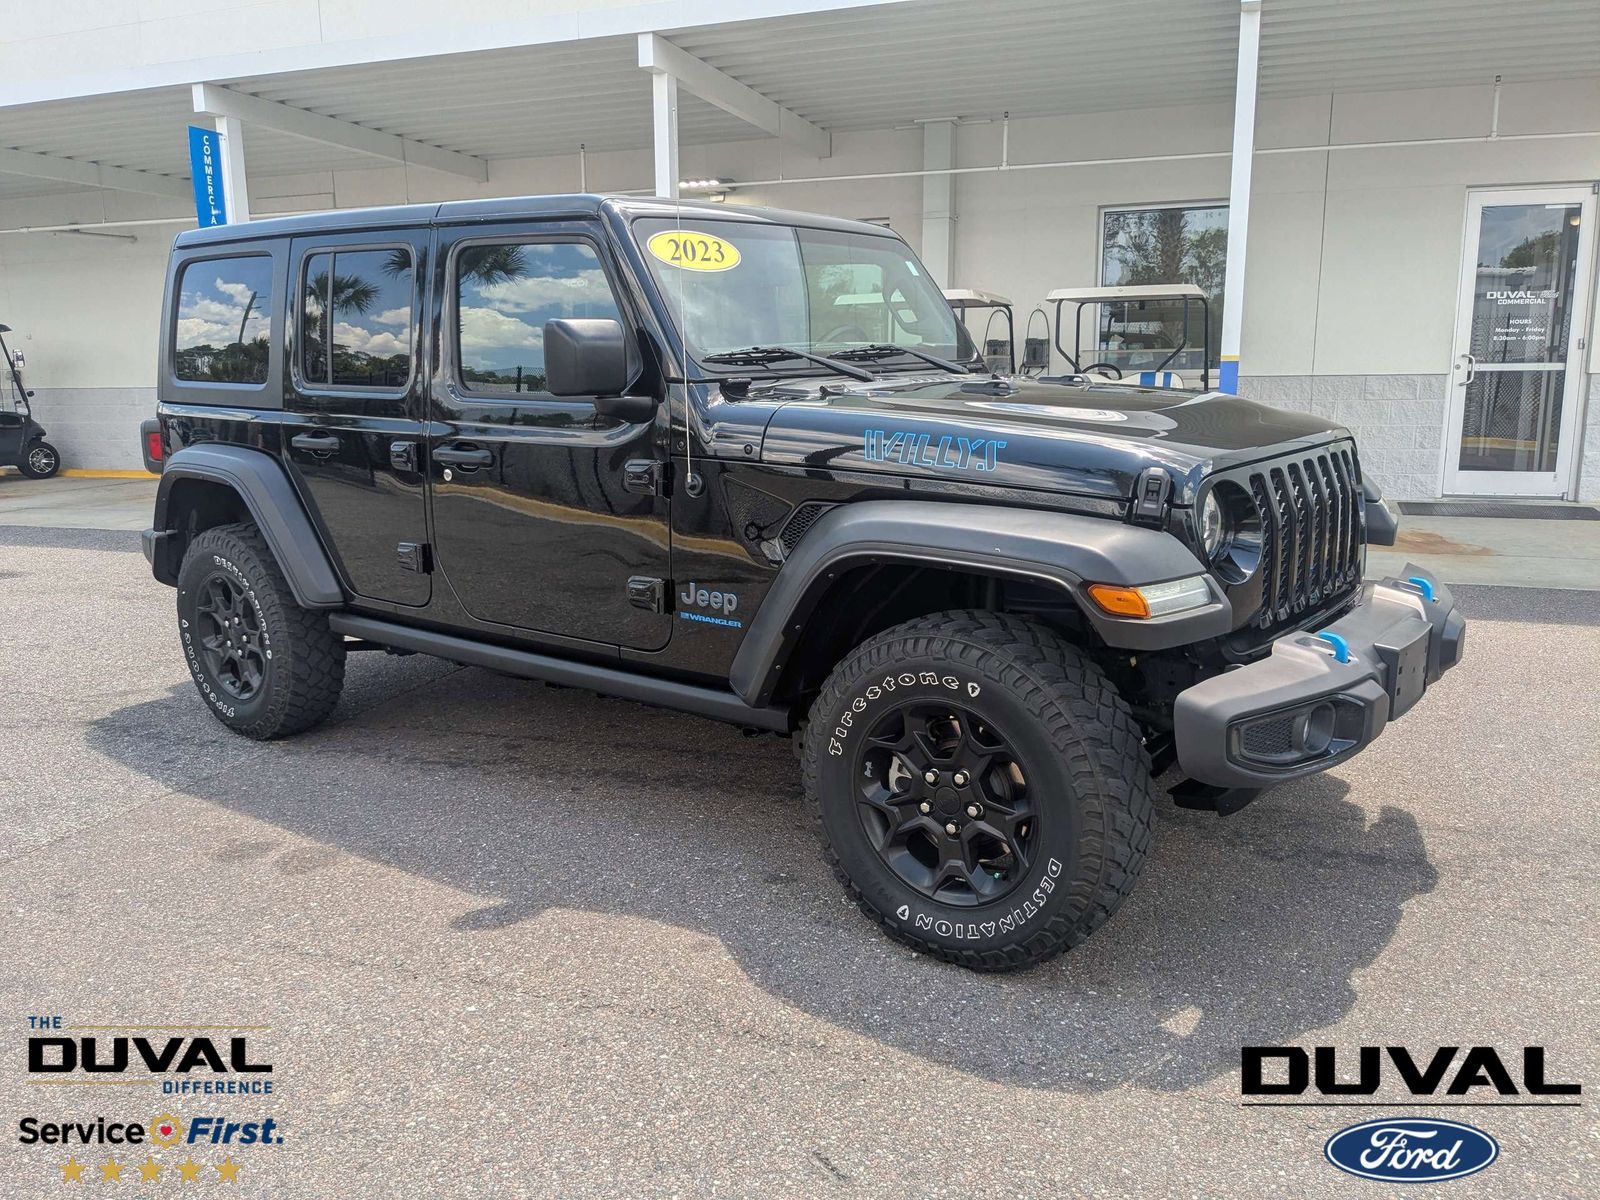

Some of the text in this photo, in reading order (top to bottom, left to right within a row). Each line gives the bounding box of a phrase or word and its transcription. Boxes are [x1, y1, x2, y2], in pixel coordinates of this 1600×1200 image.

[667, 238, 725, 263] 2023
[1486, 290, 1536, 298] DUVAL
[864, 429, 1007, 472] WILLYS
[681, 582, 738, 616] Jeep
[689, 613, 742, 629] WRANGLER
[828, 671, 960, 756] Firestone
[915, 857, 1063, 940] DESTINATION
